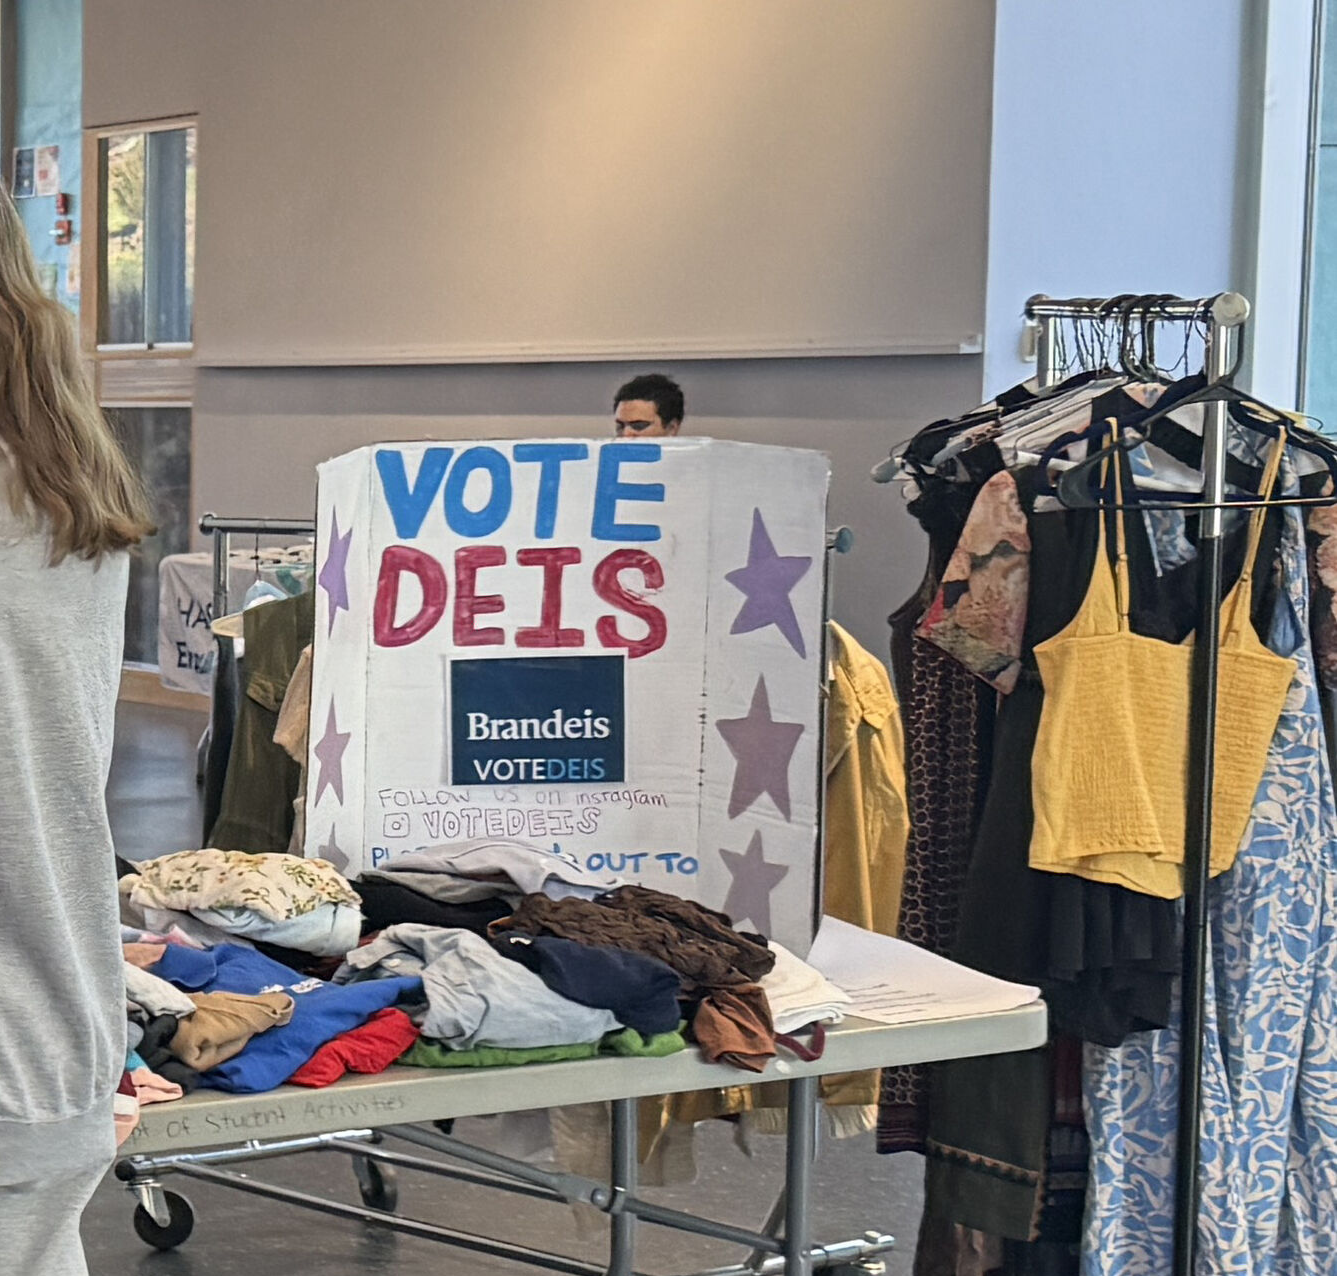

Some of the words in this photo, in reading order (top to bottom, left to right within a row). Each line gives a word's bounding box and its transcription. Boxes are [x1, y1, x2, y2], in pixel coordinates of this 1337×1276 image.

[375, 443, 665, 541] VOTE
[373, 545, 667, 659] DEIS
[467, 708, 611, 741] Brandeis
[473, 758, 605, 781] VOTEDEIS
[423, 807, 601, 840] VOTEDEIS
[586, 852, 650, 874] OUT
[655, 852, 699, 875] TO
